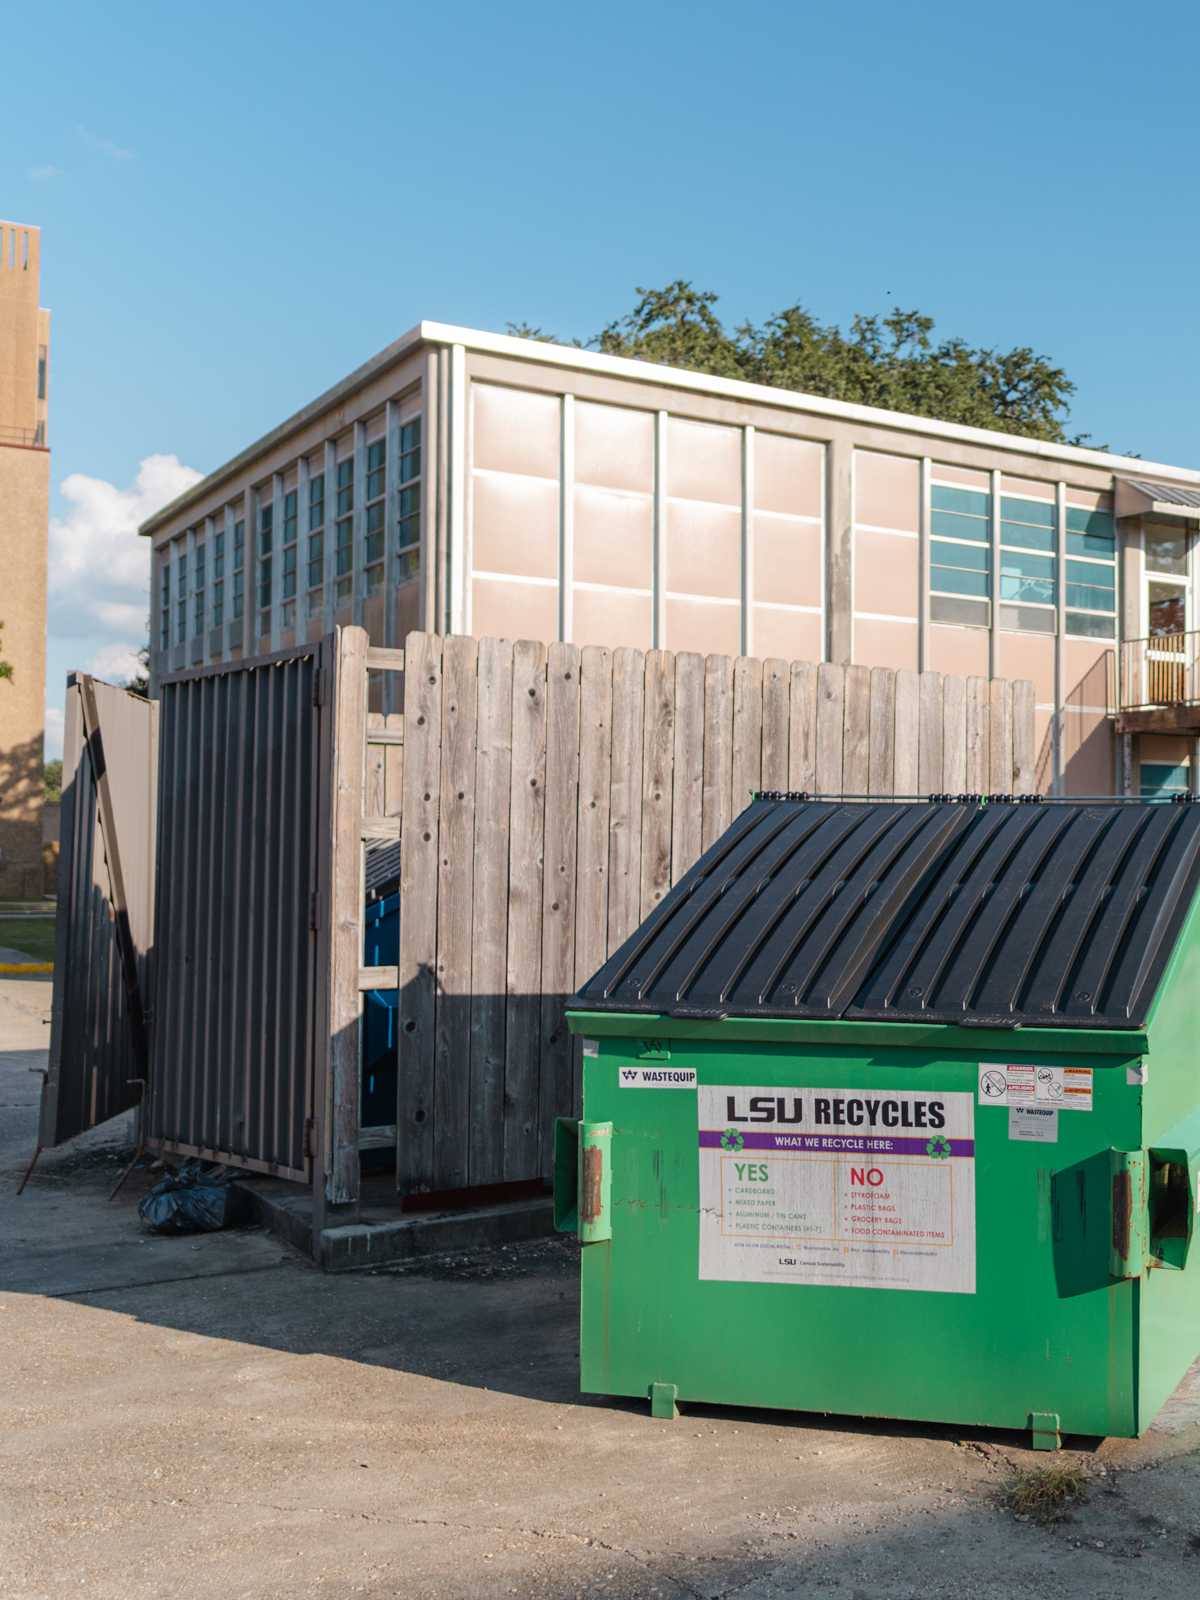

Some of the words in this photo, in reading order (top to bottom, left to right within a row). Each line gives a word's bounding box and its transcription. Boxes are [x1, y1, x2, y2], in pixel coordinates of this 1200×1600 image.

[642, 1071, 696, 1083] WASTEQUIP
[727, 1096, 802, 1124] LSU
[815, 1099, 945, 1129] RECYCLES
[774, 1136, 801, 1147] WHAT
[803, 1137, 820, 1148] WE
[822, 1138, 864, 1150] RECYCLE
[866, 1140, 894, 1151] HERE:
[734, 1163, 769, 1182] YES
[850, 1167, 884, 1186] NO
[735, 1187, 775, 1195] CARDBOARD
[851, 1191, 890, 1200] STYROFOAM
[851, 1204, 877, 1212] PLASTIC
[884, 1217, 902, 1225] BAGS
[761, 1224, 802, 1232] CONTAINERS
[872, 1229, 925, 1238] CONTAMINATED
[926, 1231, 945, 1239] ITEMS
